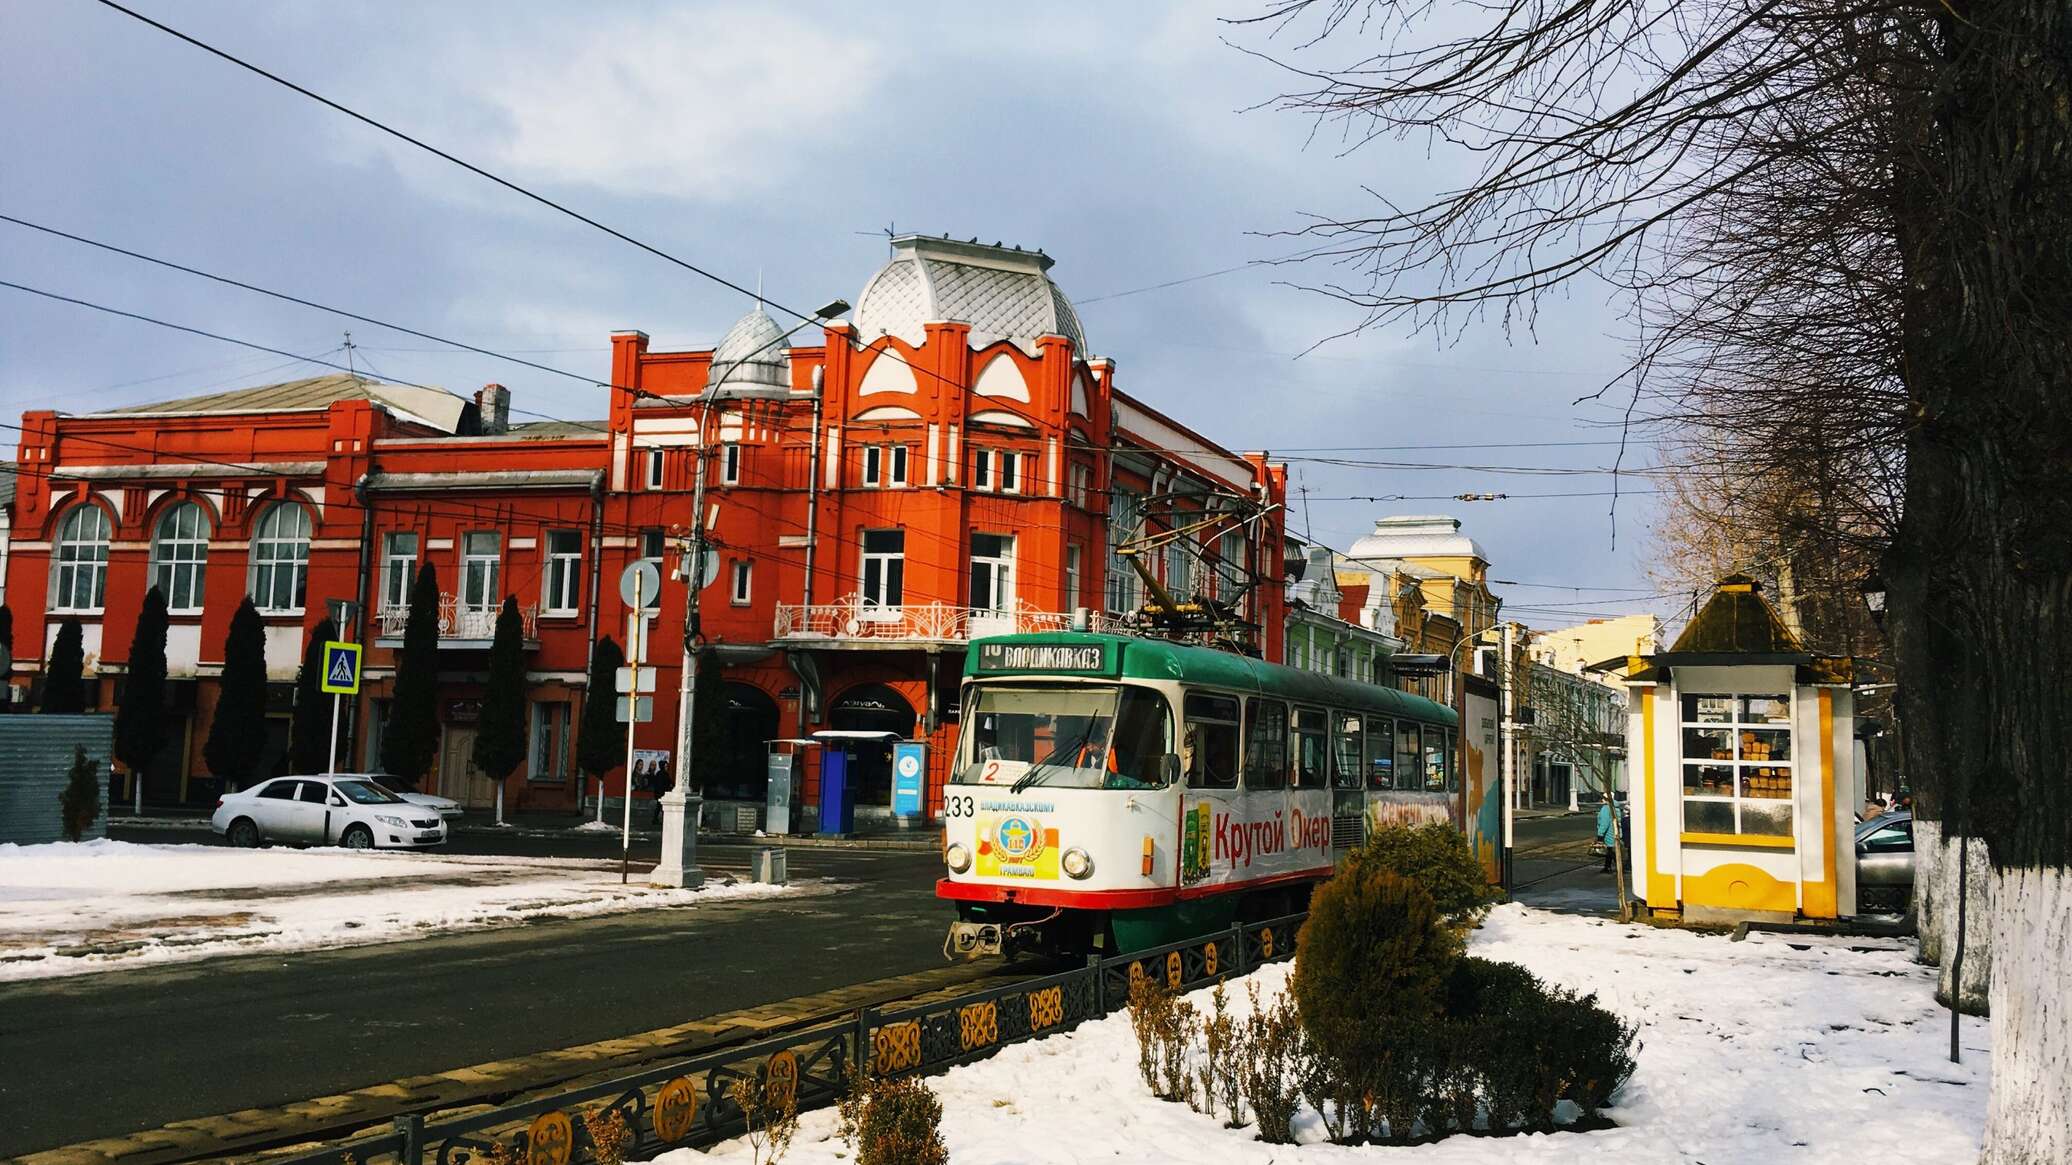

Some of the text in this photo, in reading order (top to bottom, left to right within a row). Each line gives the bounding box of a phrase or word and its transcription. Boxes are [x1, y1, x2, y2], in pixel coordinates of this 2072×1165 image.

[1004, 646, 1100, 669] ВЛАДИКАВКАЗ
[985, 762, 999, 781] 2
[944, 795, 974, 818] 233
[1215, 809, 1284, 870] Крутой
[1290, 808, 1330, 856] Окер
